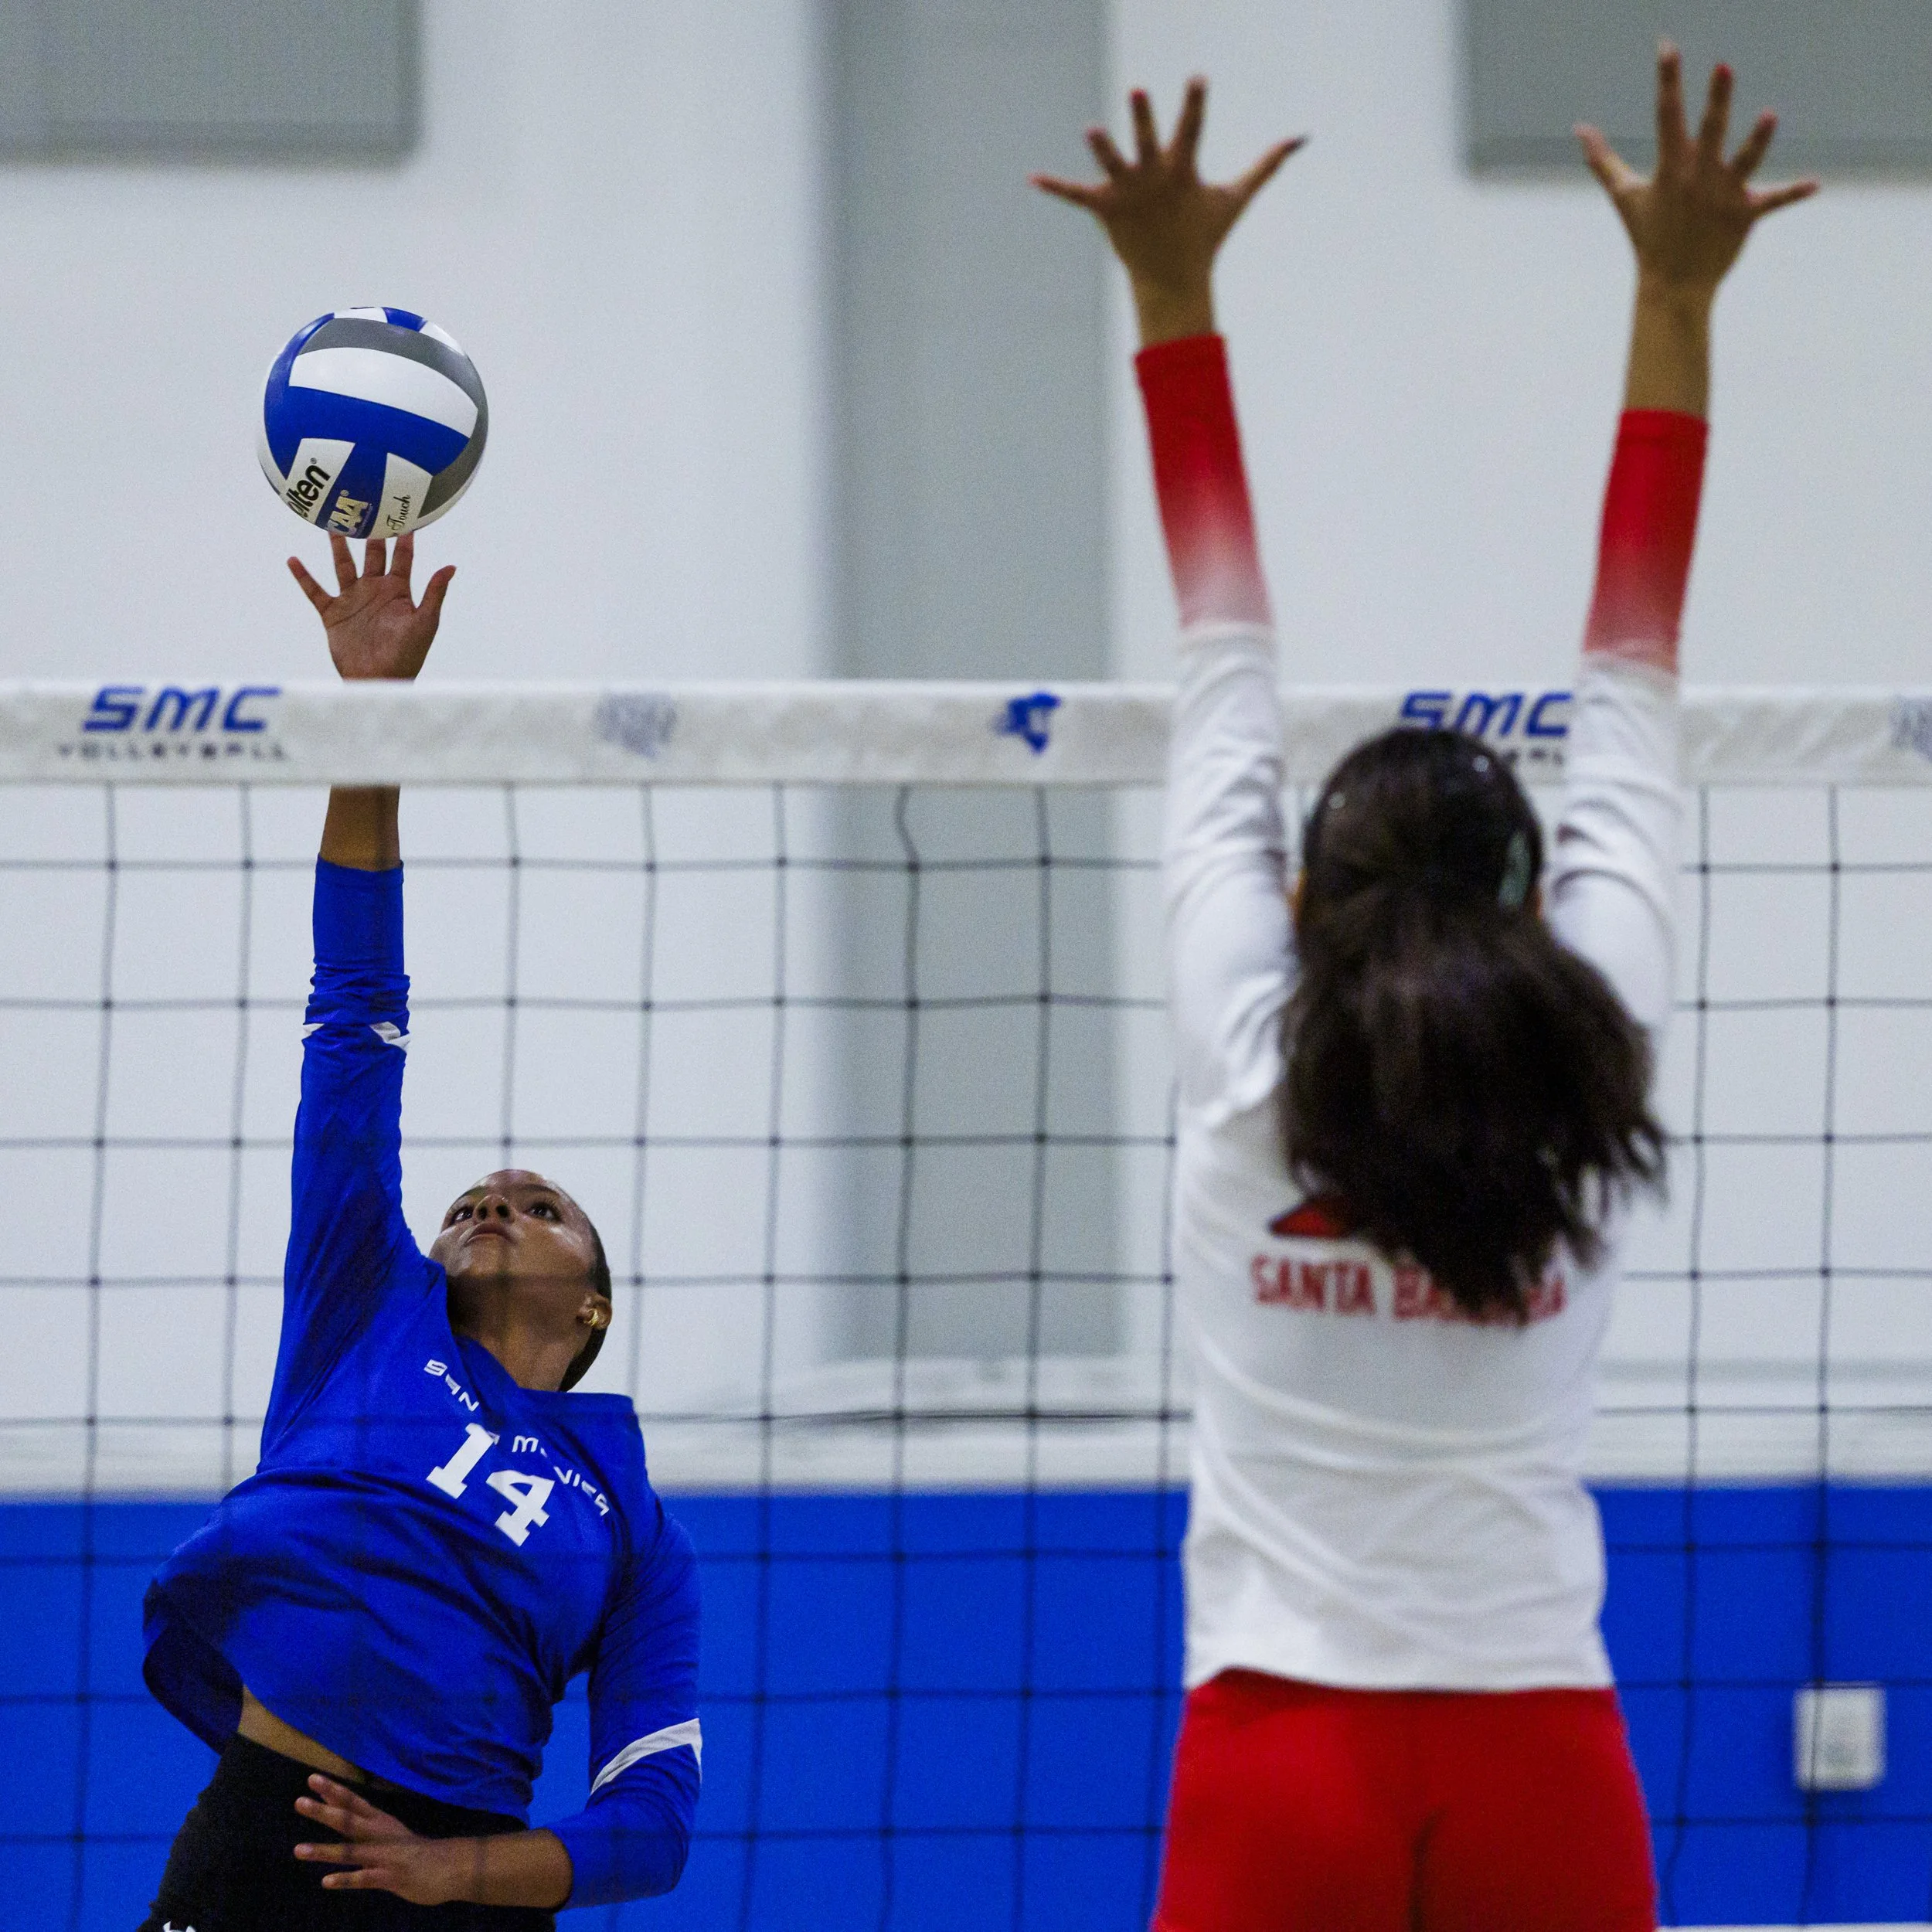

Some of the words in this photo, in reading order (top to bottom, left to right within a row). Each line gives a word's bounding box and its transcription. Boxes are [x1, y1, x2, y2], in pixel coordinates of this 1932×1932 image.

[387, 495, 412, 530] Touch
[82, 685, 282, 732] SMC
[1400, 688, 1573, 737] SMC
[1250, 1253, 1376, 1317] SANTA
[426, 1423, 555, 1546] 14
